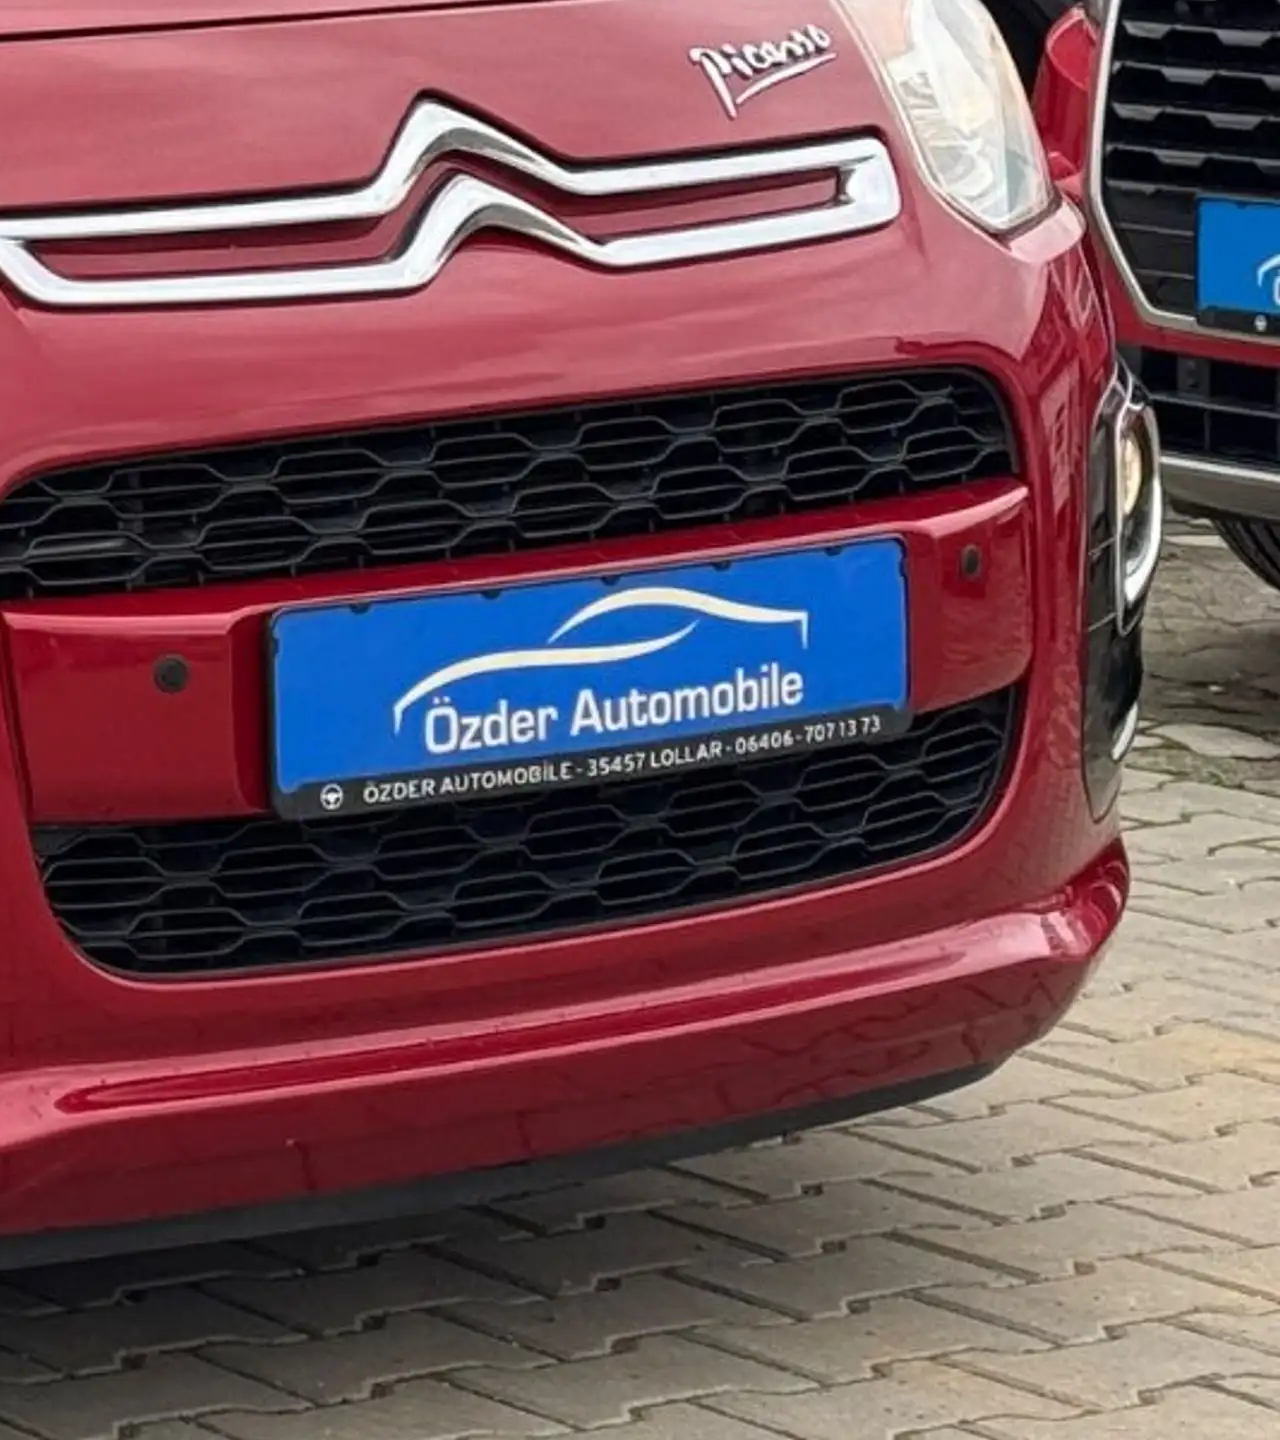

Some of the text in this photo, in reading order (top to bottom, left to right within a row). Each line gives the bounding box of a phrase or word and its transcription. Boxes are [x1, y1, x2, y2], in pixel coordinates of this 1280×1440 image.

[689, 23, 837, 120] Picasso
[425, 662, 804, 754] Özder Automobile
[363, 780, 437, 804] ÖZDER
[588, 752, 646, 778] 35457
[651, 741, 722, 768] LOLLAR
